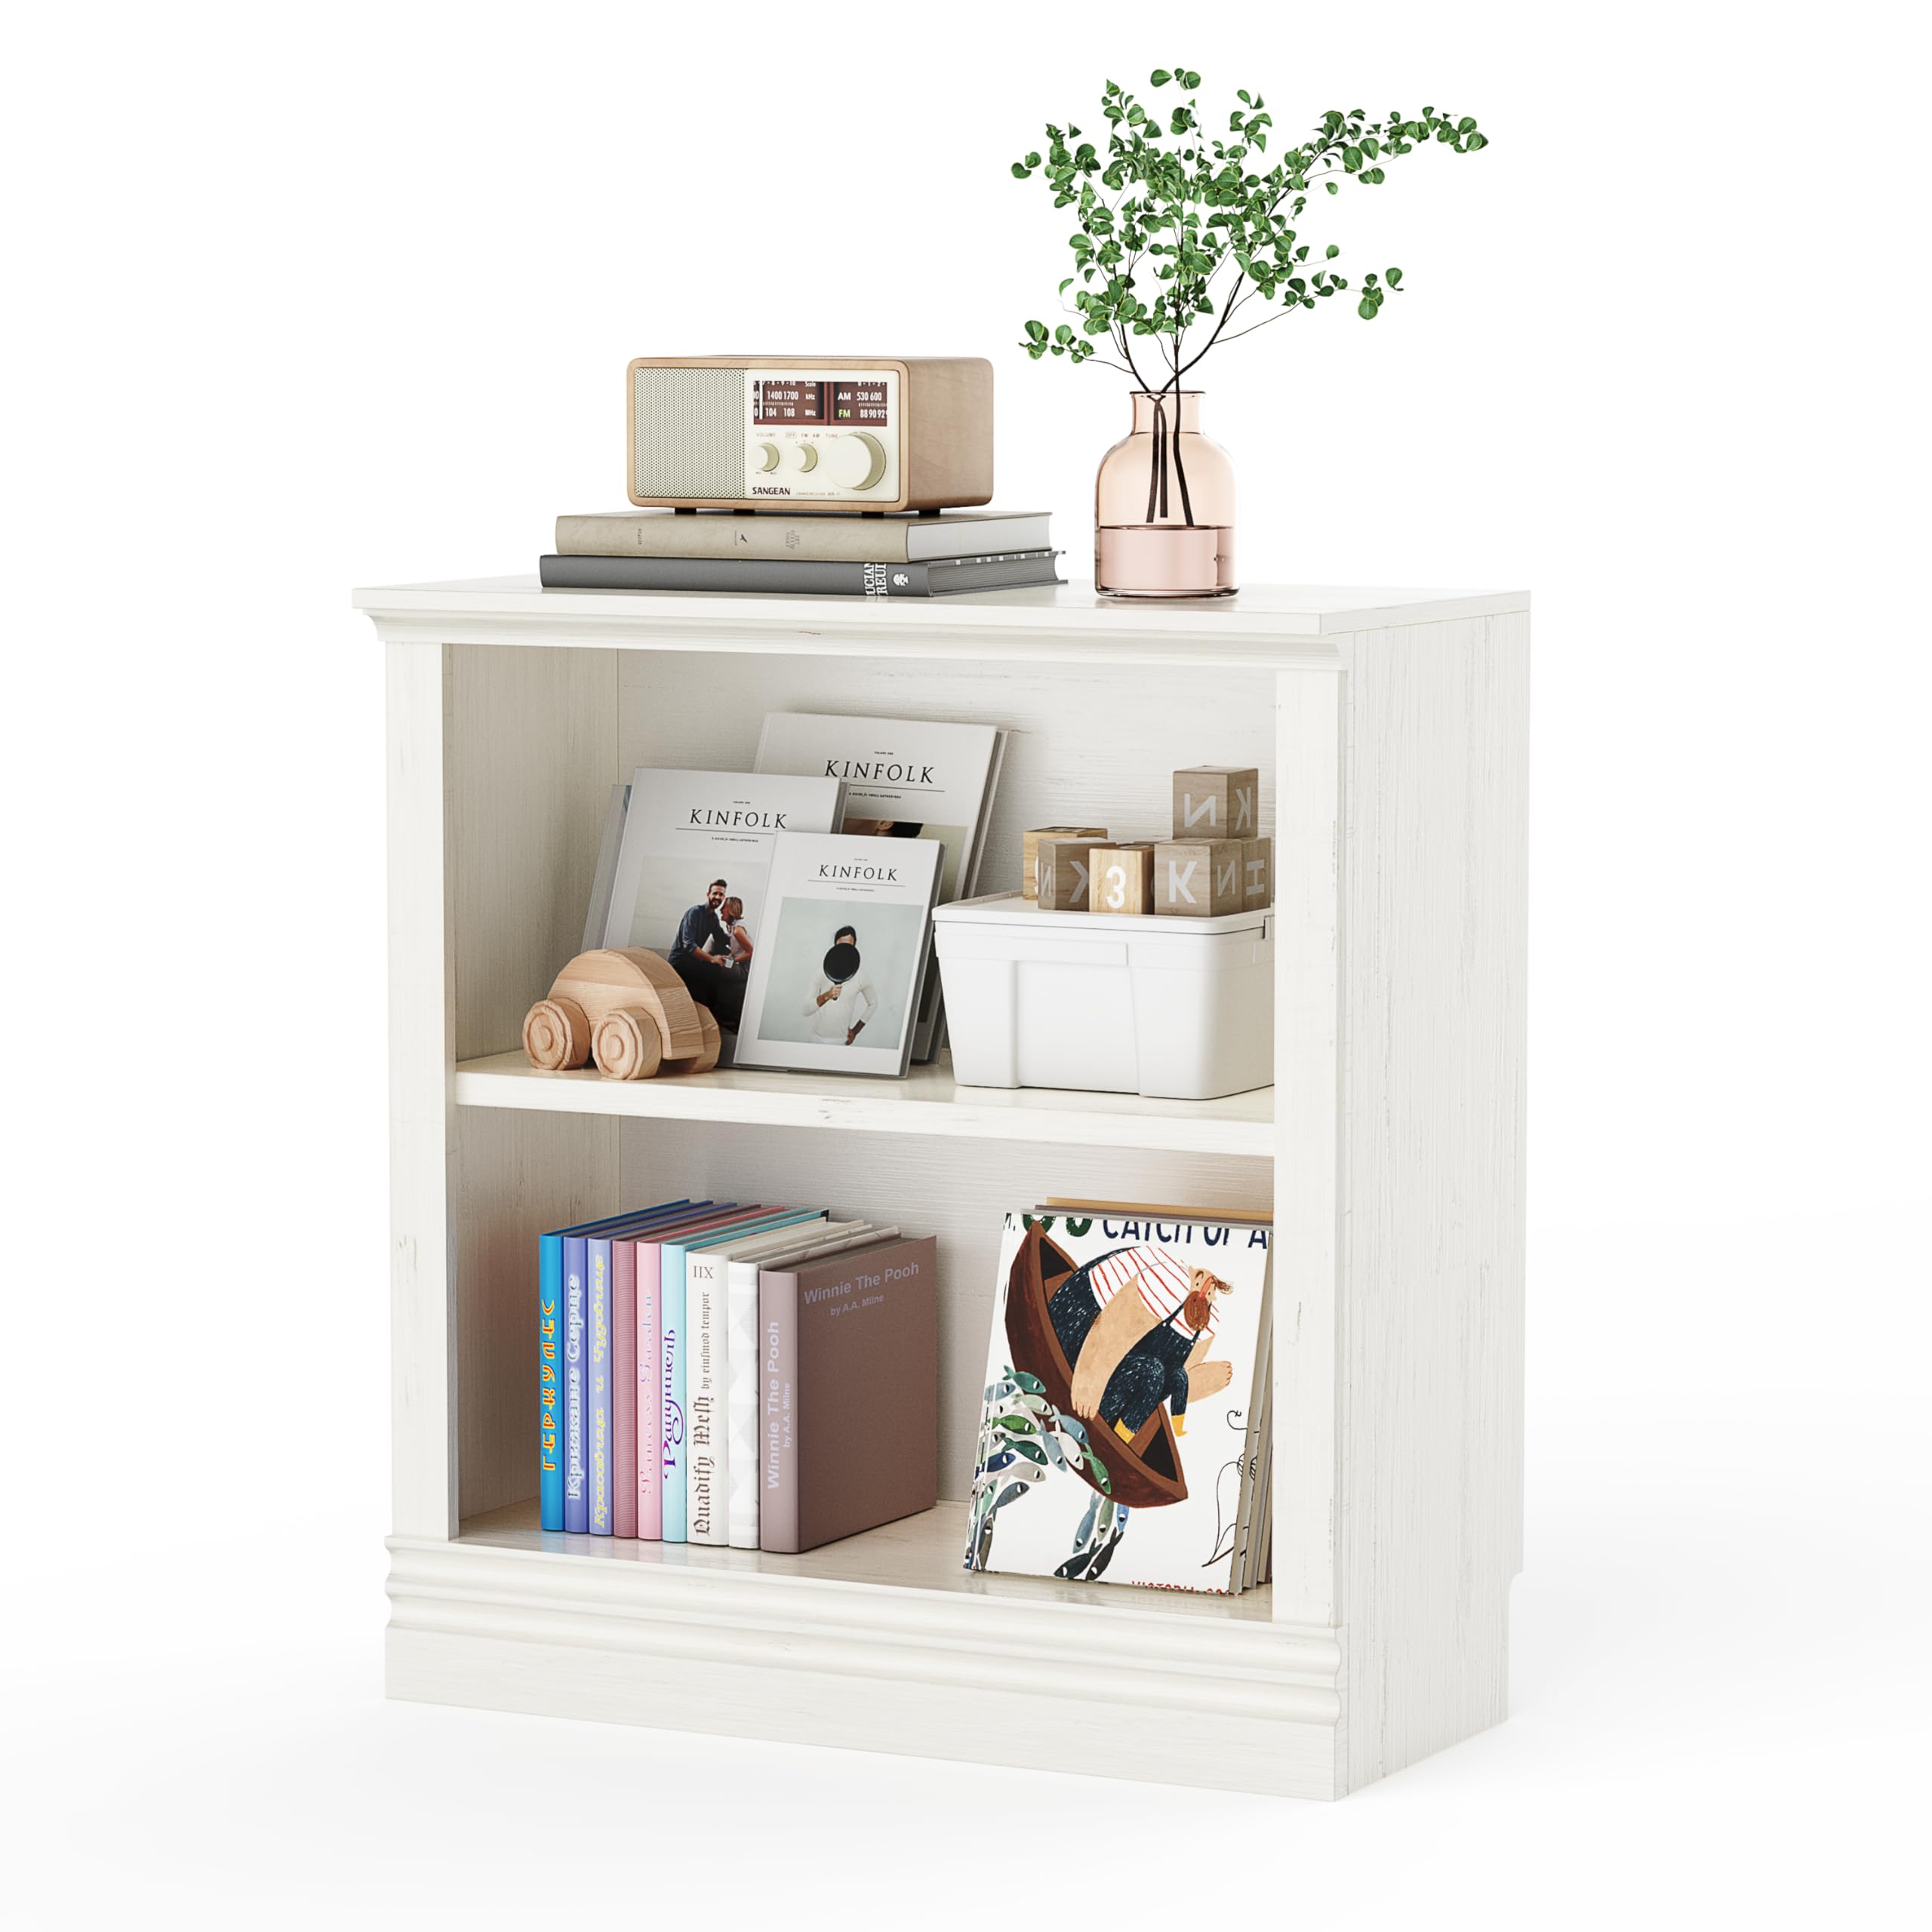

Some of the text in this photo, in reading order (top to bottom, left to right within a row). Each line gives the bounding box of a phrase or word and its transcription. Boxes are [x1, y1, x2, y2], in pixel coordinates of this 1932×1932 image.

[767, 391, 783, 400] 1400
[783, 391, 798, 400] 1700
[838, 392, 881, 401] AM 530 600
[765, 408, 777, 417] 104
[783, 408, 795, 417] 108
[838, 409, 851, 418] FM
[860, 409, 869, 418] 88
[869, 409, 877, 418] 90
[752, 487, 790, 495] SANGEAN
[824, 759, 934, 784] KINFOLK
[690, 808, 787, 829] KINFOLK
[819, 864, 898, 881] KINFOLK
[1169, 860, 1197, 903] K
[1106, 865, 1126, 909] 3
[804, 1262, 919, 1304] Winnie The Pooh
[830, 1294, 884, 1317] by A.A. Milne
[541, 1298, 556, 1471] ГЕРКУЛЕС
[767, 1321, 780, 1489] Winnie The Pooh
[783, 1435, 792, 1447] by
